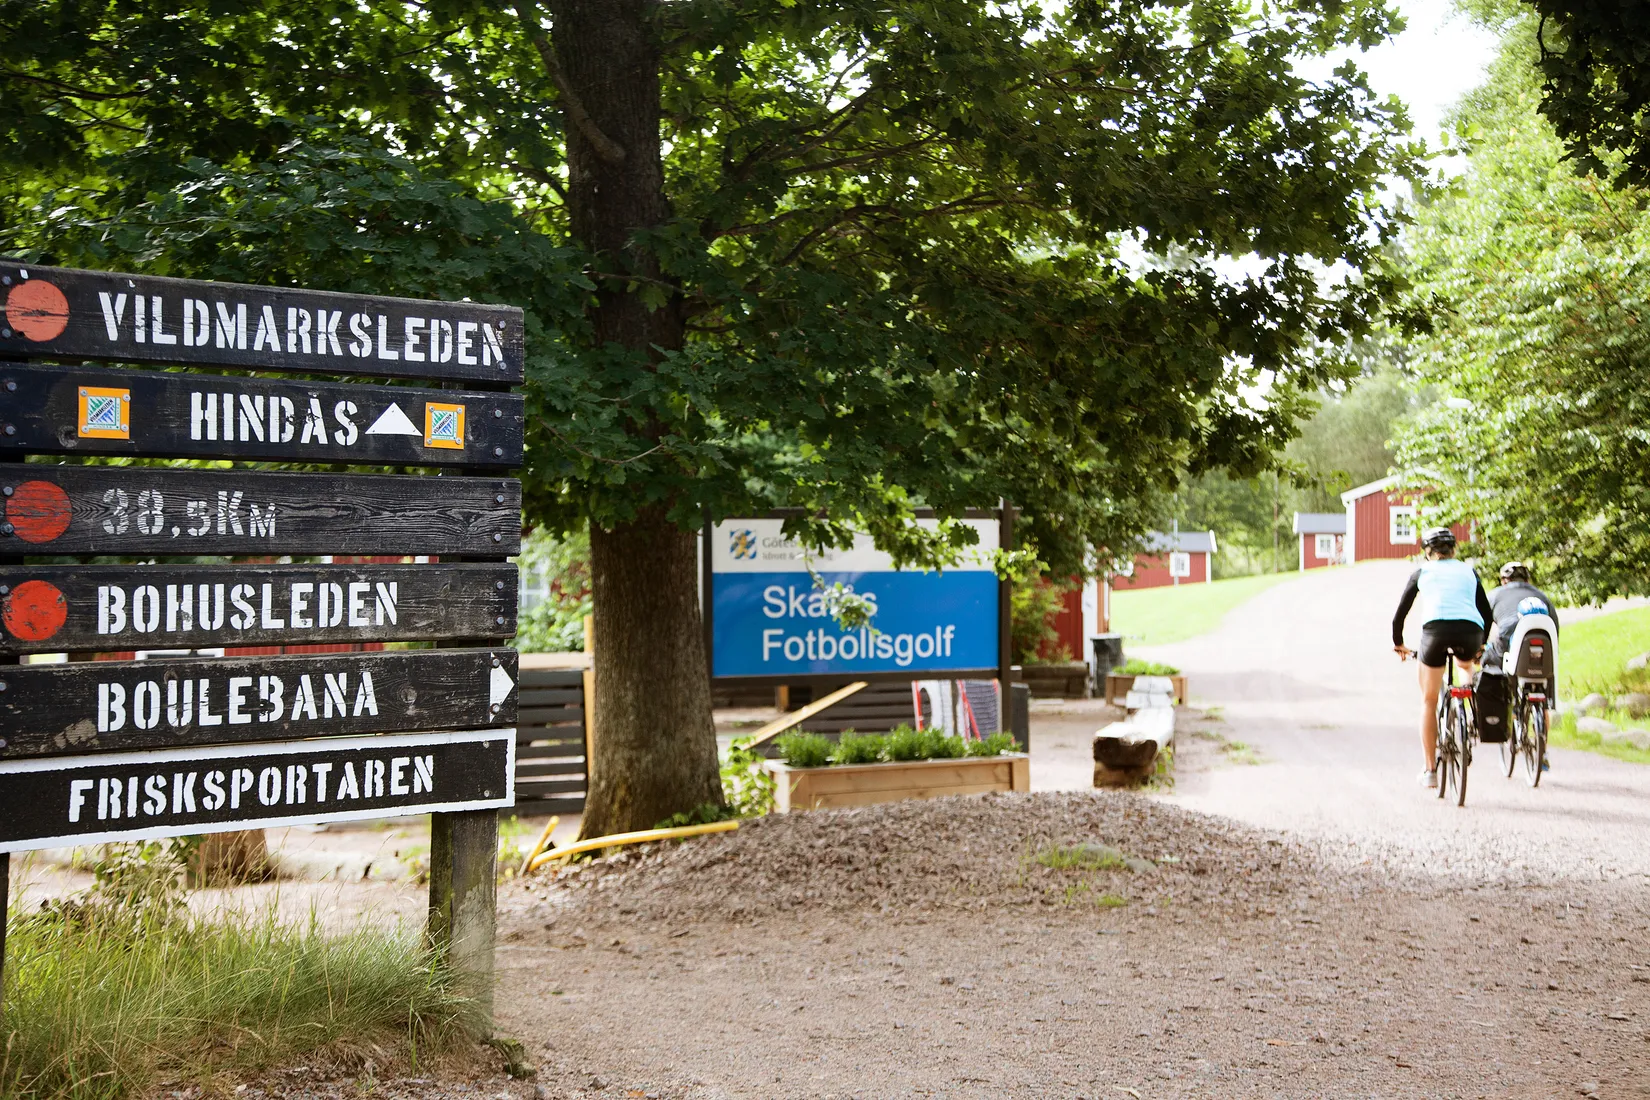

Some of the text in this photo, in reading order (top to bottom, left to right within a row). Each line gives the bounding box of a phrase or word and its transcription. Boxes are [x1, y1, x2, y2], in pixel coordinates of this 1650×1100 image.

[98, 291, 503, 367] VILDMARKSLEDEN
[190, 391, 359, 446] HINDÅS
[98, 582, 398, 635] BOHUSLEDEN
[763, 625, 955, 666] Fotbollsgolf
[98, 671, 379, 732] BOULEBANA
[68, 754, 434, 823] FRISKSPORTAREN
